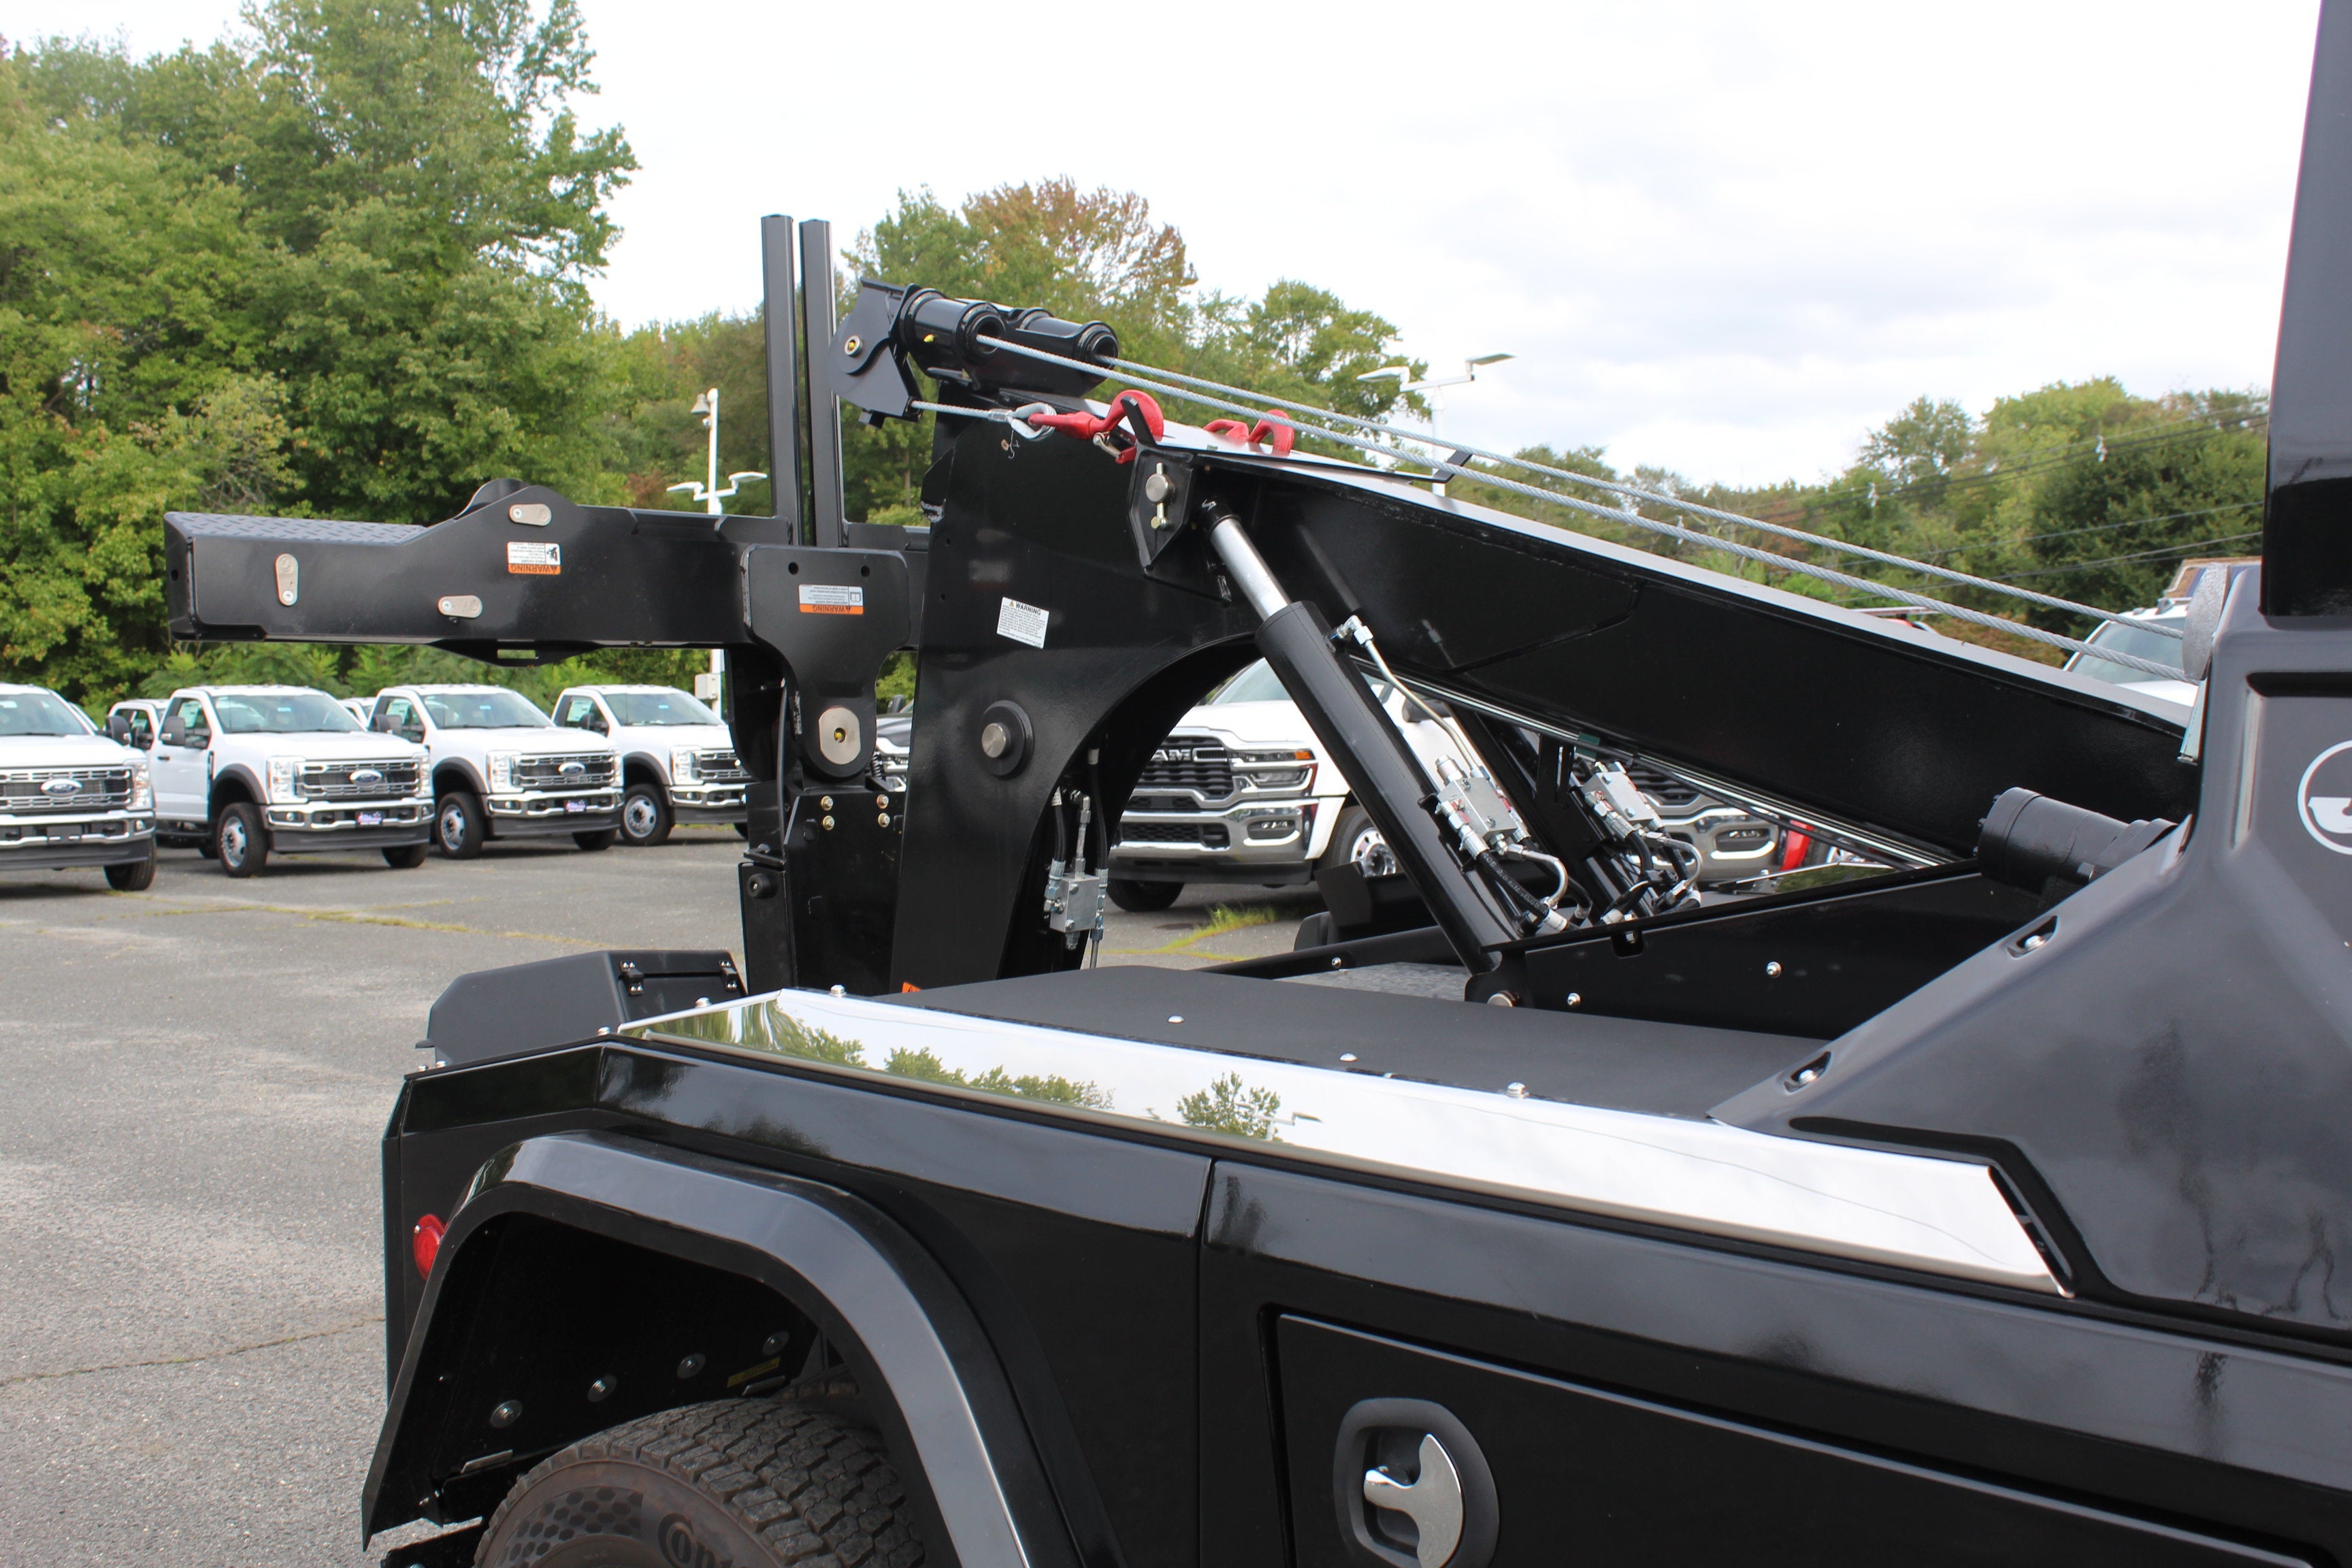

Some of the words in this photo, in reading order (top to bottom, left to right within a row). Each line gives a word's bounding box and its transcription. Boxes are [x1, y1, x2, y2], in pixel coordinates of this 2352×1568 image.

[510, 564, 550, 574] WARNING
[812, 604, 845, 613] WARNING
[1015, 602, 1041, 615] WARNING
[1150, 749, 1191, 762] AM
